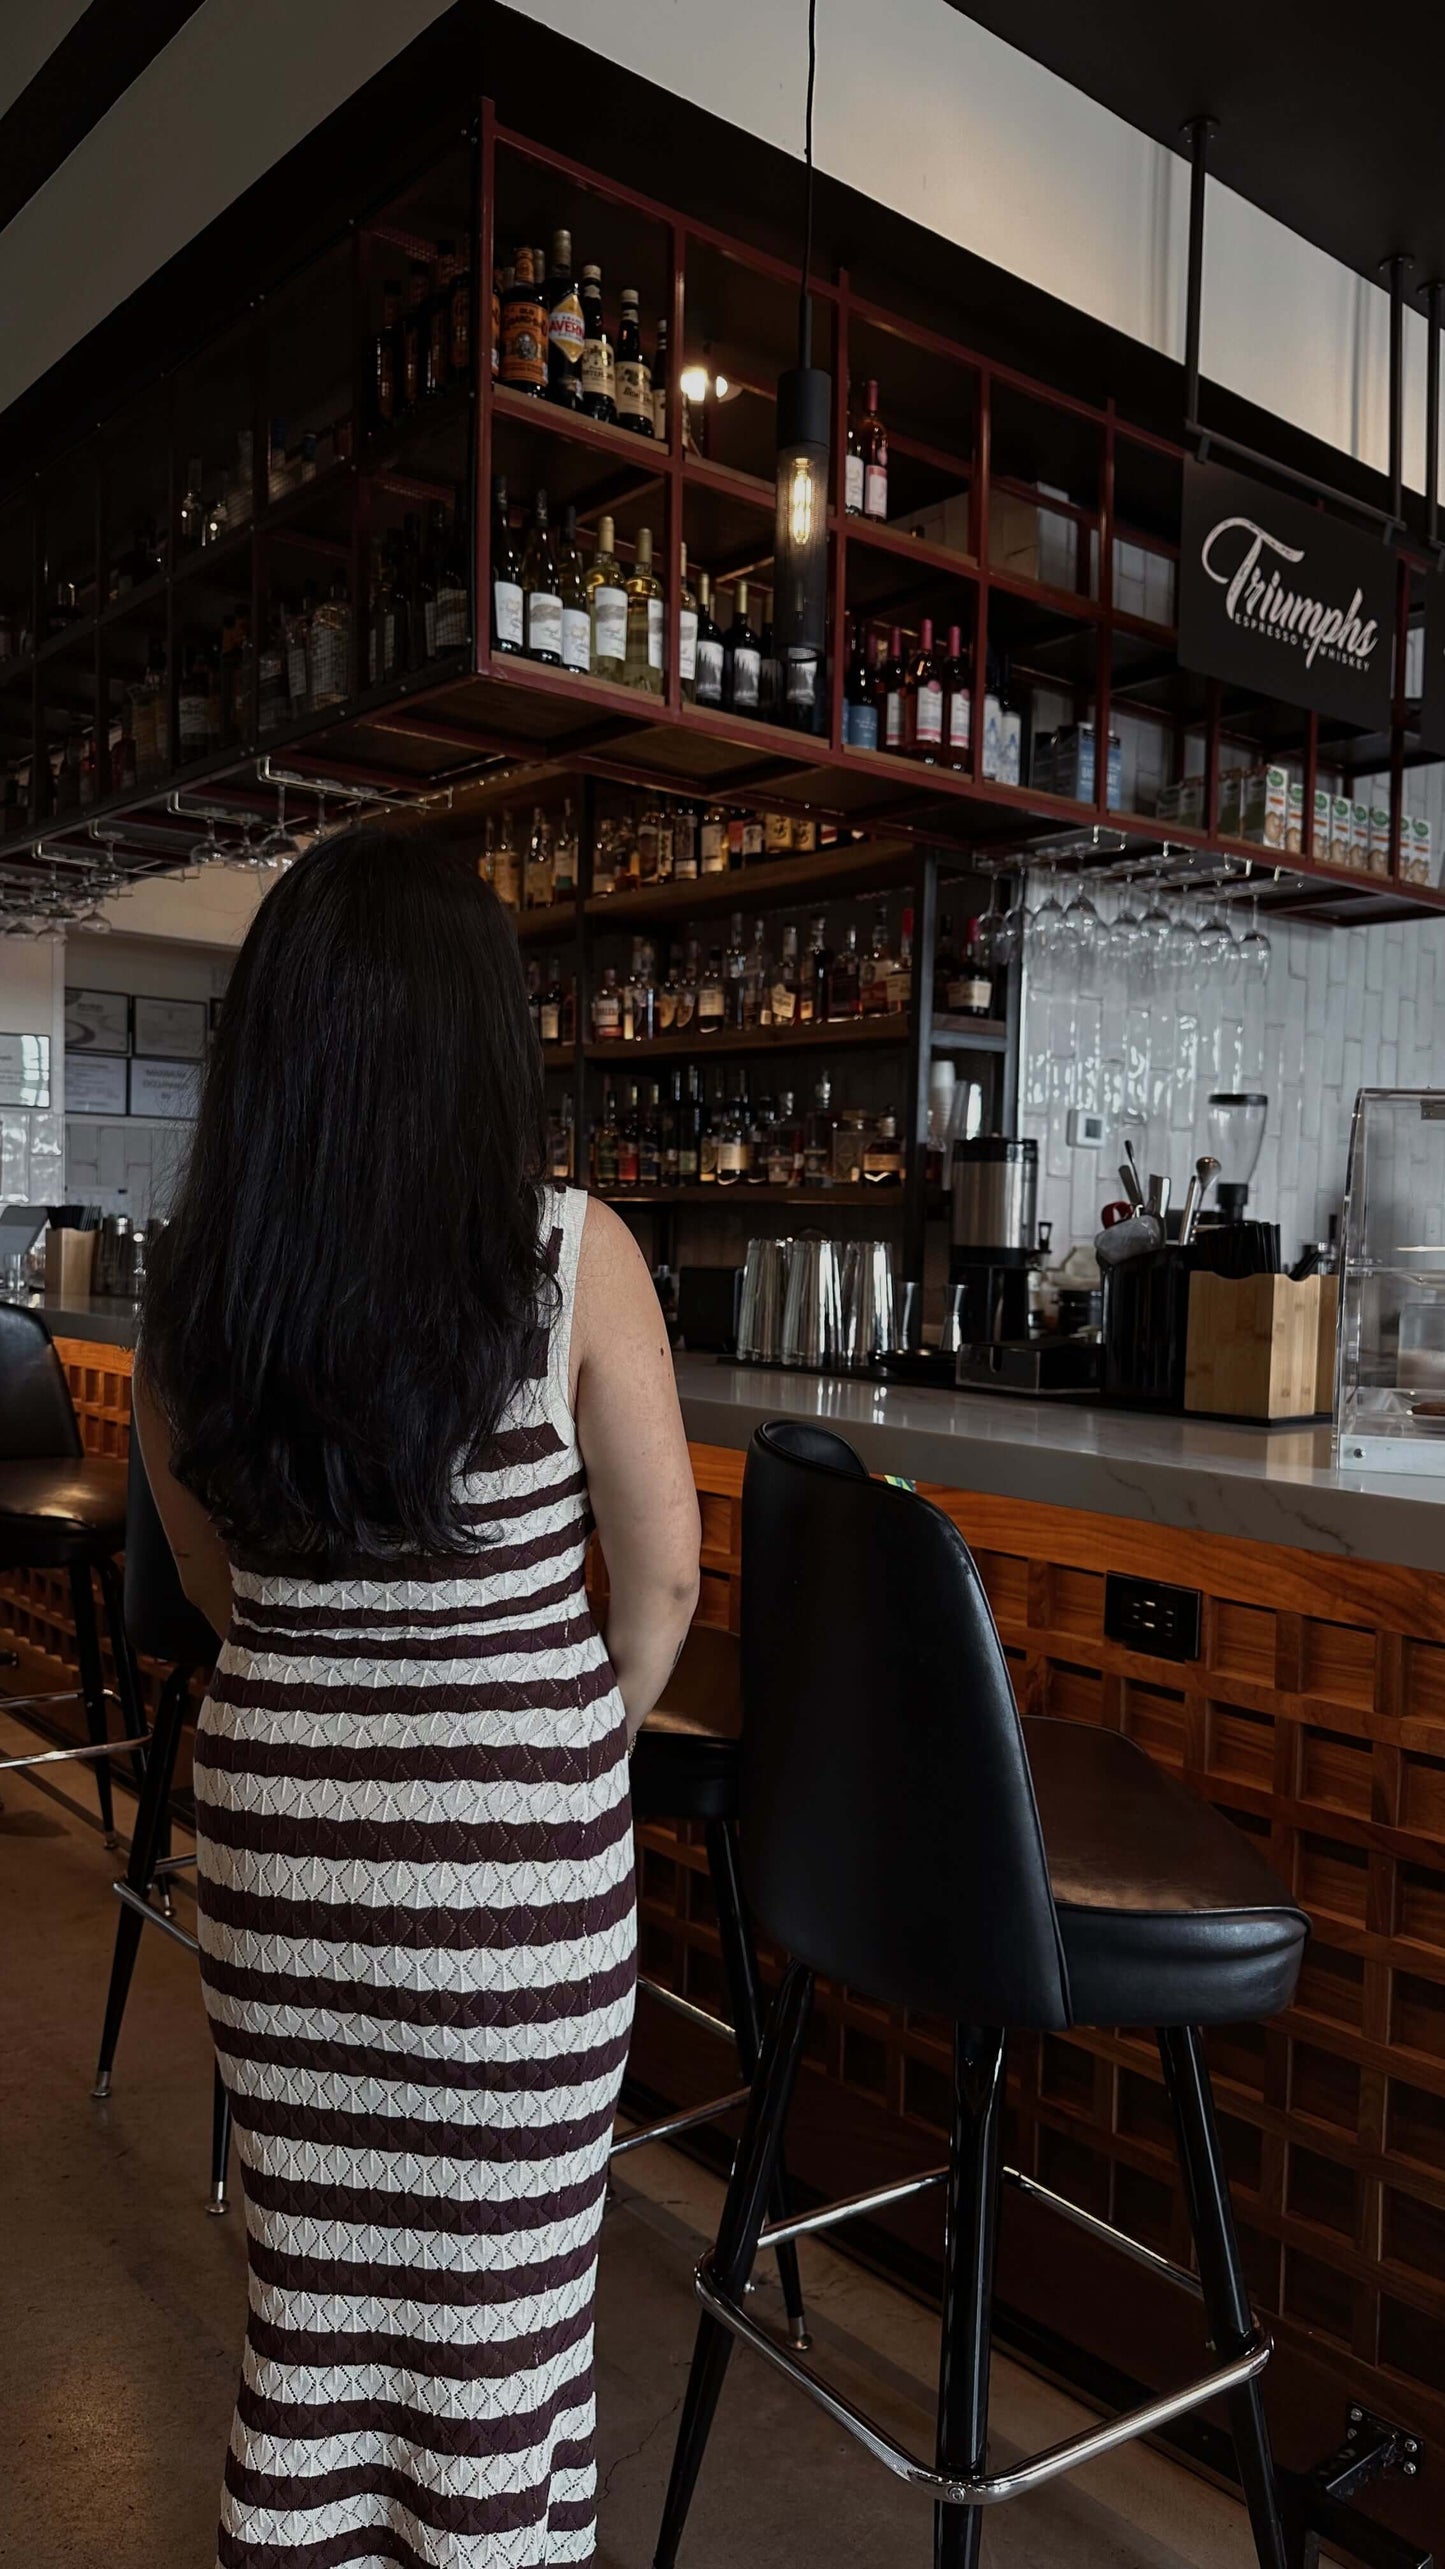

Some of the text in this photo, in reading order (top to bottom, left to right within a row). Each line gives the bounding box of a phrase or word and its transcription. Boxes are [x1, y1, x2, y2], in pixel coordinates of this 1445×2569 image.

[1201, 516, 1379, 670] Triumphs
[1234, 612, 1298, 645] ESPRESSO
[1318, 644, 1370, 672] WHISKEY
